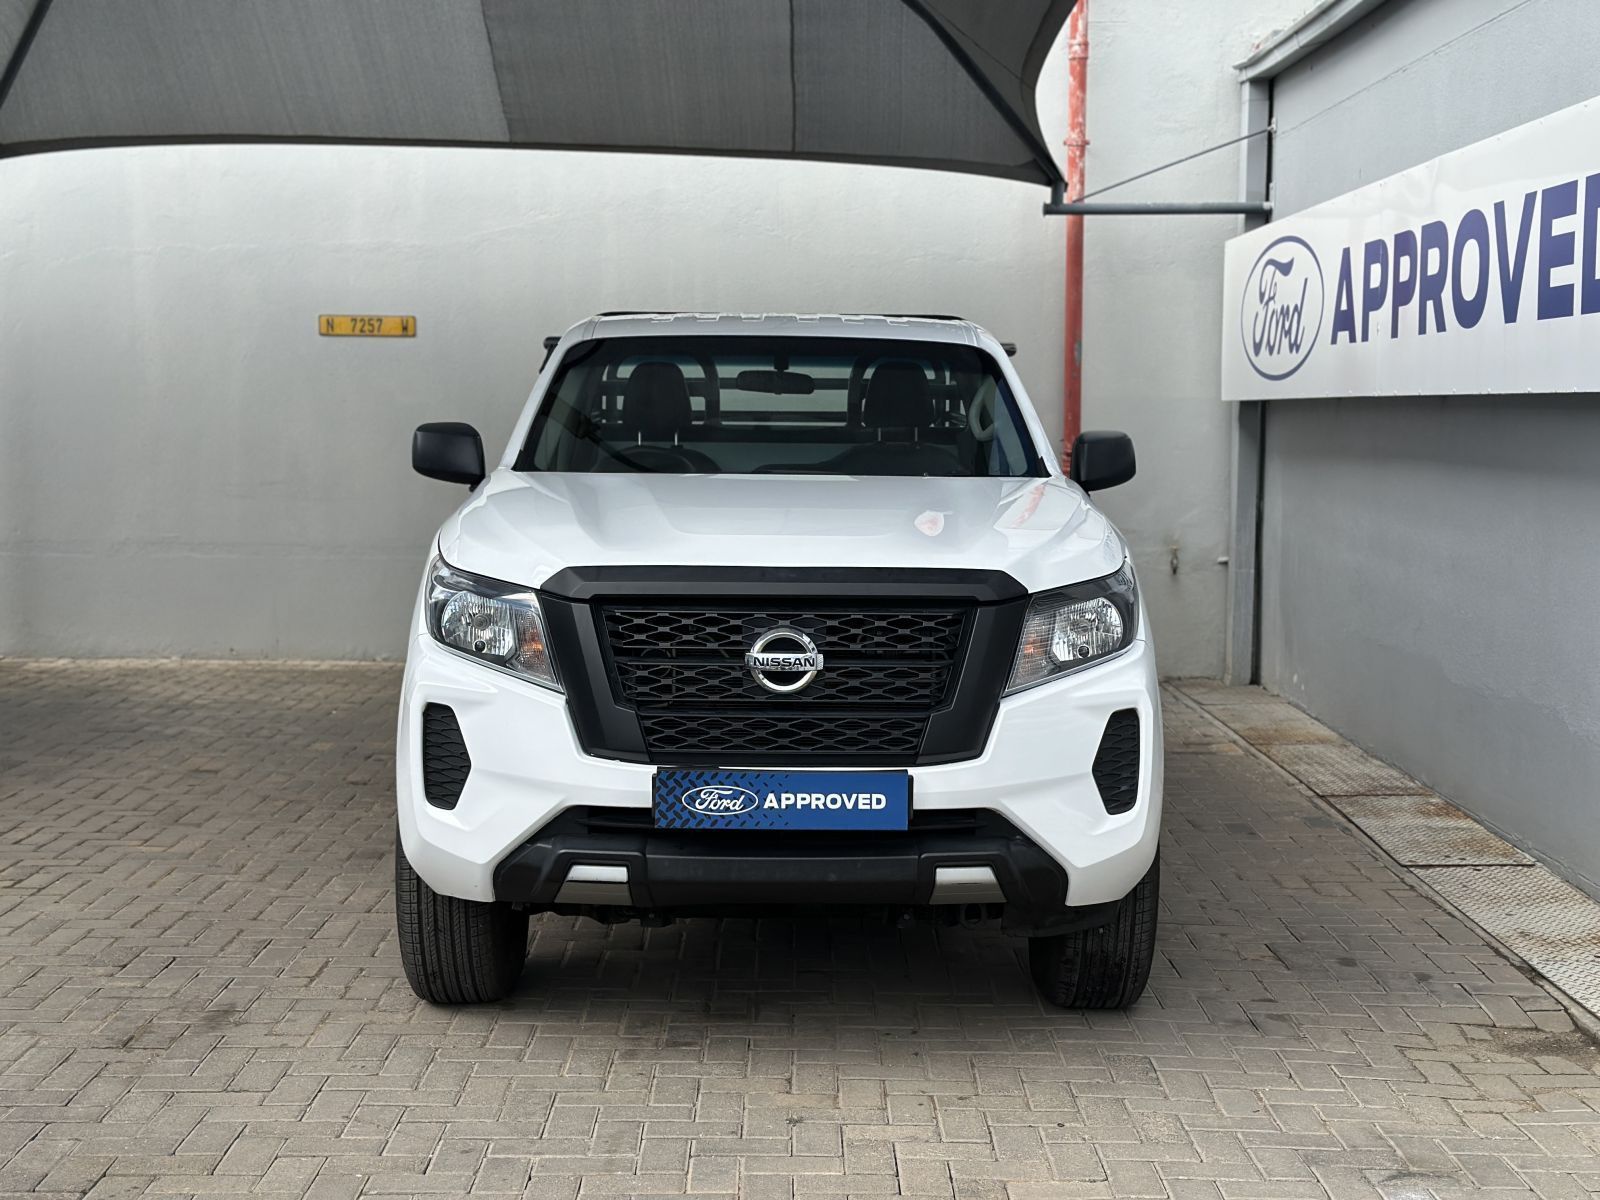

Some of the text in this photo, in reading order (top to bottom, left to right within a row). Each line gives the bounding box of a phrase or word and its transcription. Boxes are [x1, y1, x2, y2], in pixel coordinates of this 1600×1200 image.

[1252, 256, 1309, 358] Ford
[326, 318, 334, 333] N
[350, 318, 383, 333] 7257
[753, 656, 815, 668] NISSAN
[695, 788, 887, 812] Ford APPROVED
